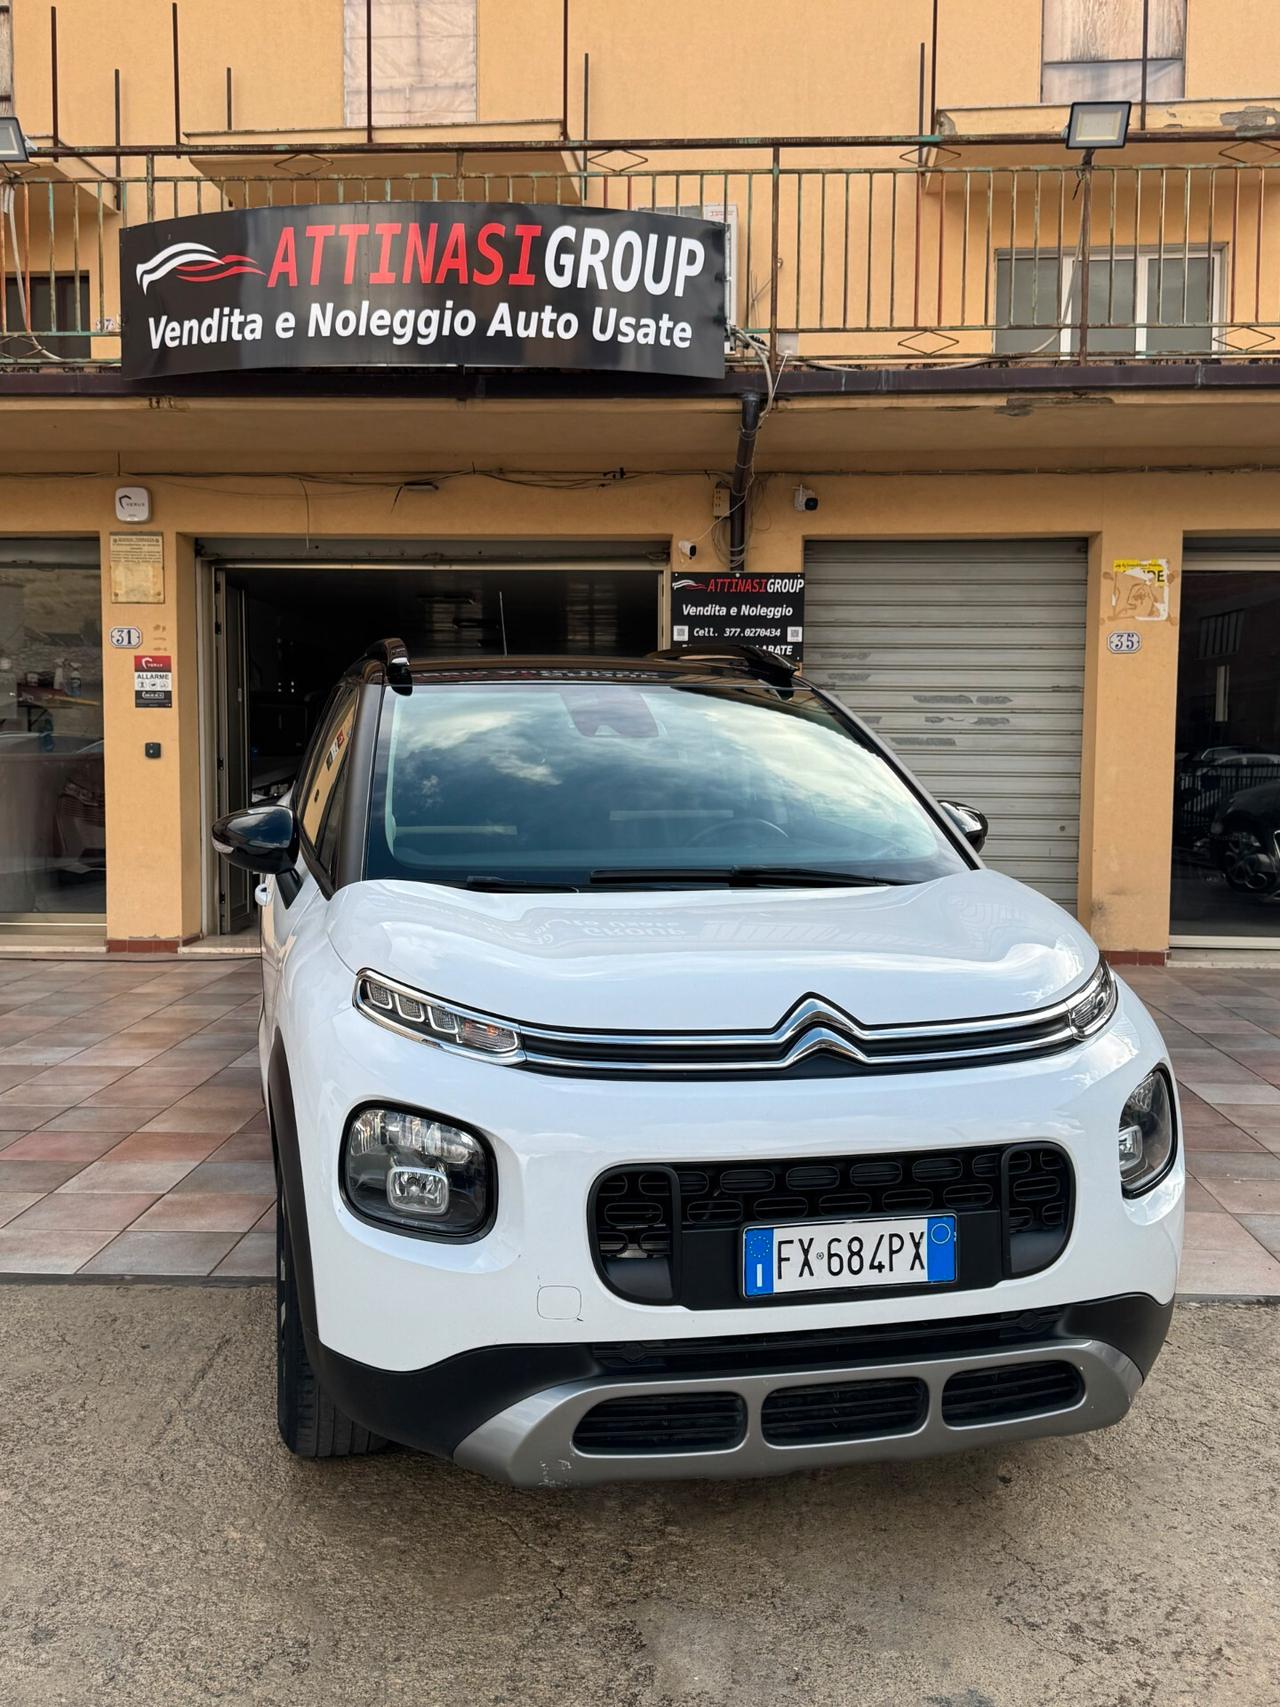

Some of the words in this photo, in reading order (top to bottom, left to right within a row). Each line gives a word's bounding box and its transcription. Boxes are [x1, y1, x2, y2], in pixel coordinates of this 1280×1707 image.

[148, 306, 264, 350] Vendita
[274, 311, 296, 339] e
[307, 299, 477, 346] Noleggio
[486, 301, 580, 340] Auto
[592, 306, 693, 349] Usate
[682, 604, 727, 616] Vendita
[730, 606, 738, 616] e
[740, 604, 794, 618] Noleggio
[116, 629, 132, 645] 31
[693, 627, 719, 637] Cell.
[1114, 634, 1136, 650] 35
